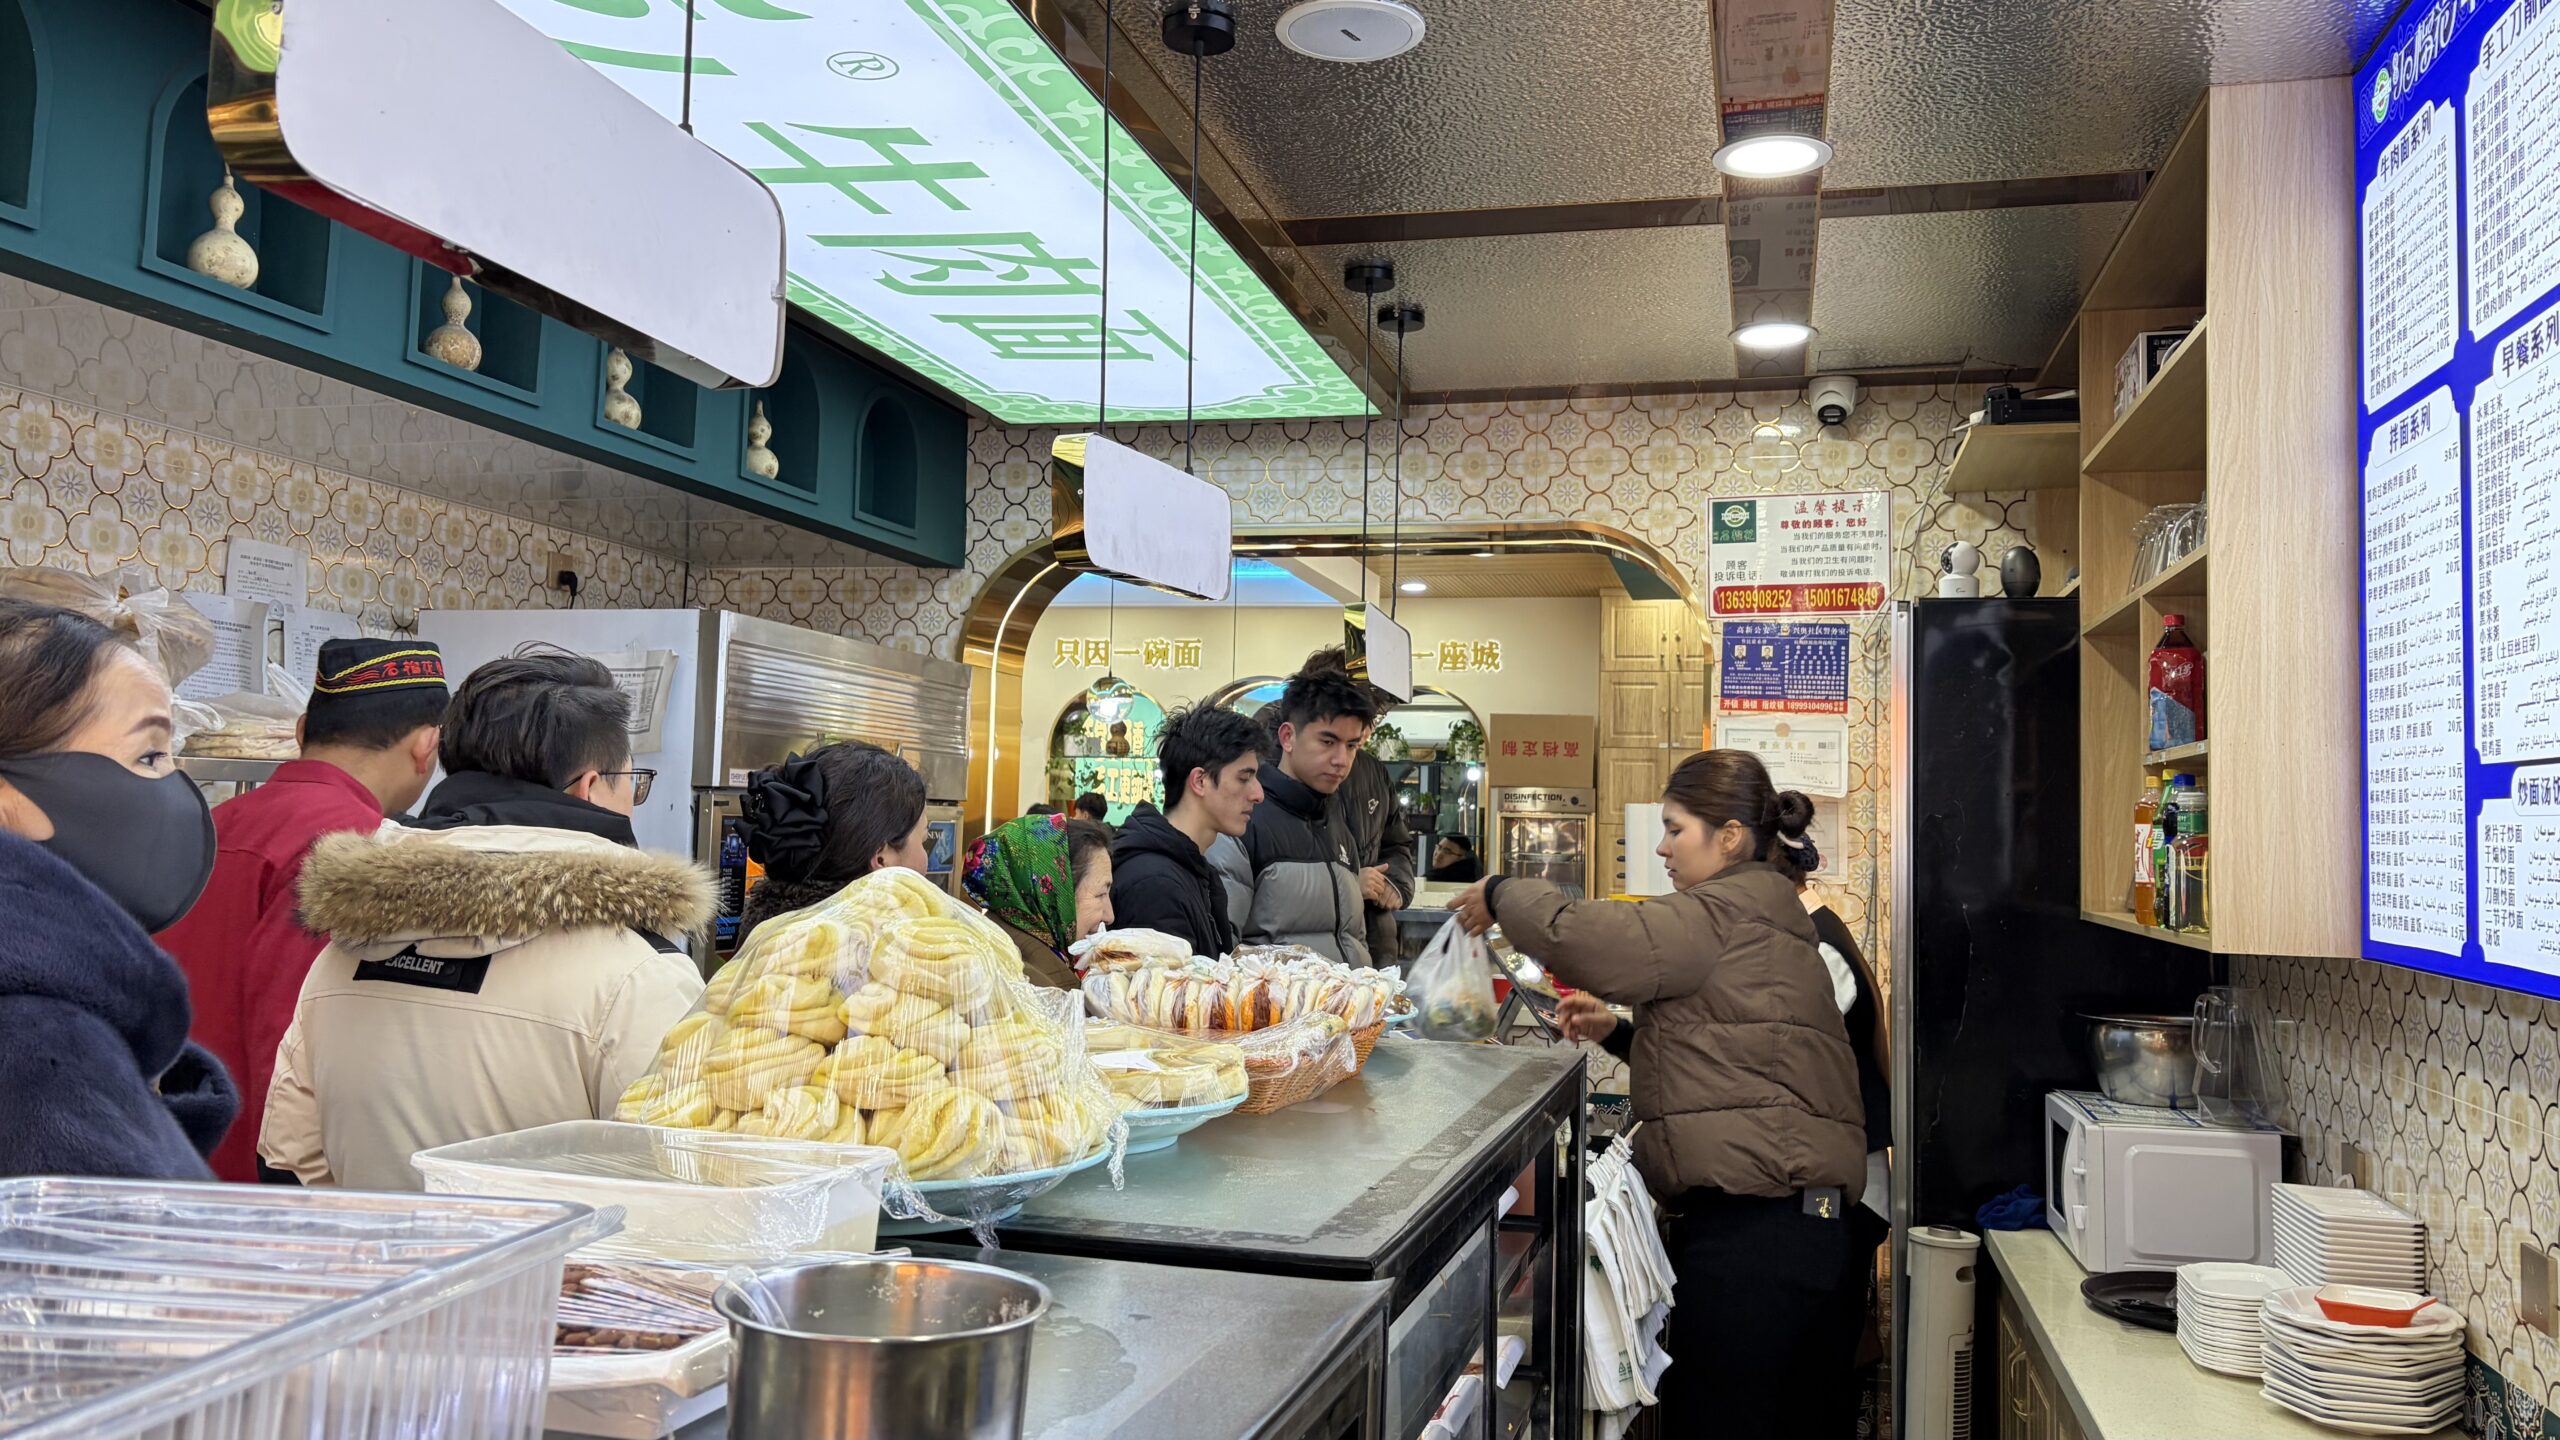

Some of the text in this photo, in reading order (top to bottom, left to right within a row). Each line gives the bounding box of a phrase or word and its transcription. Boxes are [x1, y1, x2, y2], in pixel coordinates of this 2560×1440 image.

[2380, 106, 2431, 182] 牛肉面系列
[2433, 134, 2446, 161] 10元
[2433, 153, 2446, 180] 12元
[2434, 173, 2447, 199] 12元
[2434, 192, 2447, 218] 12元
[2434, 211, 2447, 238] 14元
[743, 122, 1198, 364] 牛肉面
[2435, 231, 2448, 257] 14元
[2435, 251, 2448, 276] 16元
[2435, 270, 2448, 295] 20元
[2436, 290, 2449, 315] 22元
[2436, 309, 2449, 334] 10元
[2436, 329, 2449, 353] 10元
[2502, 311, 2560, 378] 早餐系列
[2476, 391, 2502, 425] 水果玉米
[2389, 402, 2430, 454] 拌面系列
[2444, 439, 2458, 460] 38元
[2444, 485, 2459, 506] 28元
[1794, 500, 1866, 516] 温馨提示
[2445, 509, 2459, 529] 25元
[2445, 531, 2459, 551] 25元
[1725, 560, 1747, 570] 顾客
[2446, 553, 2460, 574] 20元
[1720, 588, 1878, 609] 13639908252 15001674849
[2446, 599, 2460, 620] 20元
[2447, 622, 2460, 643] 20元
[2479, 620, 2499, 646] 小米粥
[1054, 638, 1203, 668] 只因一碗面
[1412, 640, 1502, 672] 一座城
[2447, 645, 2461, 666] 20元
[2447, 669, 2461, 689] 20元
[1724, 700, 1738, 708] 开锁
[2447, 692, 2461, 711] 20元
[2447, 715, 2462, 733] 20元
[1502, 740, 1580, 758] 高档定制
[2448, 762, 2462, 778] 18元
[2449, 785, 2463, 801] 18元
[2449, 808, 2463, 824] 18元
[2449, 832, 2463, 847] 18元
[2450, 855, 2463, 871] 18元
[2450, 878, 2464, 894] 15元
[2450, 902, 2464, 917] 15元
[2451, 925, 2464, 942] 15元
[2485, 927, 2500, 947] 汤饭
